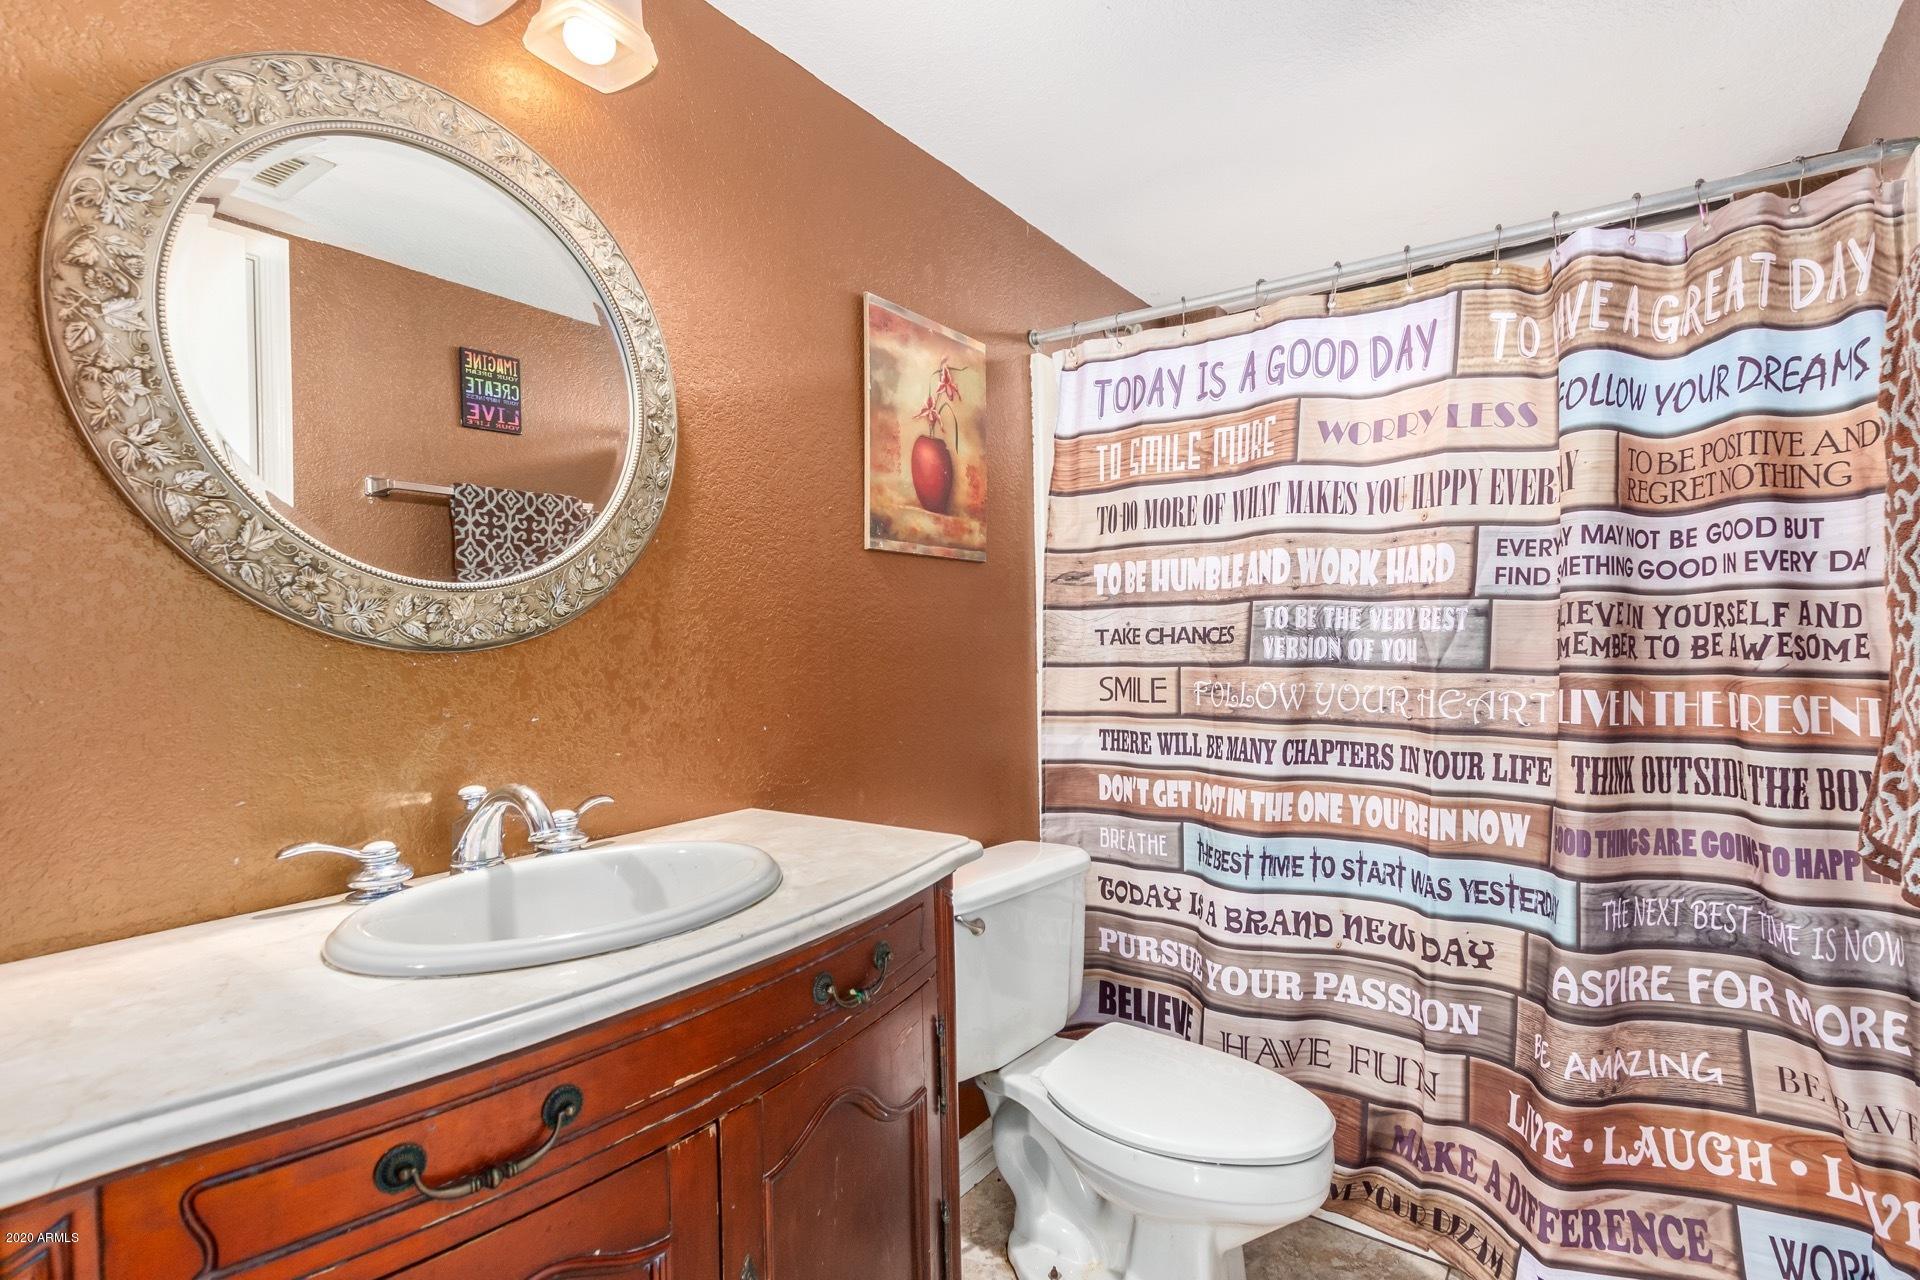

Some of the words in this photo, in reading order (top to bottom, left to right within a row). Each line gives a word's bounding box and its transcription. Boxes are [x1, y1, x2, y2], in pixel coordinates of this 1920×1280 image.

[1623, 284, 1639, 337] A
[1651, 252, 1776, 344] GREAT
[1790, 232, 1876, 313] DAY
[1489, 312, 1540, 361] TO
[1094, 365, 1185, 419] TODAY
[1197, 361, 1226, 401] IS
[1239, 350, 1256, 393] A
[1266, 338, 1359, 386] GOOD
[1370, 318, 1437, 381] DAY
[1655, 364, 1730, 416] YOUR
[1736, 336, 1871, 394] DREAMS
[1096, 442, 1121, 482] TO
[1130, 431, 1201, 476] SMILE
[1214, 415, 1276, 467] MORE
[1317, 405, 1438, 446] WORRY
[1446, 401, 1538, 429] LESS
[1628, 449, 1652, 474] TO
[1657, 448, 1696, 475] BE
[1701, 431, 1805, 468] POSITIVE
[1811, 419, 1881, 457] AND
[1097, 504, 1117, 536] TO
[1122, 500, 1138, 532] DO
[1144, 495, 1197, 530] MORE
[1202, 492, 1226, 526] OF
[1232, 481, 1281, 523] WHAT
[1286, 479, 1357, 515] MAKES
[1366, 476, 1406, 516] YOU
[1412, 468, 1483, 509] HAPPY
[1628, 473, 1716, 504] REGRET
[1719, 460, 1852, 497] NOTHING
[1581, 524, 1623, 545] MAY
[1626, 527, 1661, 549] NOT
[1669, 528, 1697, 549] BE
[1706, 516, 1777, 544] GOOD
[1784, 517, 1824, 540] BUT
[1094, 563, 1121, 595] TO
[1125, 560, 1147, 594] BE
[1151, 553, 1244, 592] HUMBLE
[1246, 549, 1291, 586] AND
[1297, 547, 1381, 587] WORK
[1386, 543, 1456, 586] HARD
[1494, 567, 1550, 586] FIND
[1638, 555, 1717, 580] GOOD
[1723, 553, 1736, 573] IN
[1744, 550, 1818, 572] EVERY
[1095, 627, 1140, 645] TAKE
[1145, 626, 1234, 645] CHANCES
[1264, 605, 1288, 629] TO
[1295, 605, 1317, 629] BE
[1323, 606, 1361, 630] THE
[1369, 606, 1415, 631] VERY
[1418, 607, 1468, 632] BEST
[1627, 603, 1644, 629] IN
[1654, 600, 1790, 631] YOURSELF
[1798, 600, 1862, 629] AND
[1263, 635, 1342, 661] VERSION
[1348, 637, 1375, 662] OF
[1380, 638, 1418, 663] YOU
[1644, 635, 1679, 660] TO
[1690, 633, 1723, 660] BE
[1729, 633, 1870, 662] AWESOME
[1099, 676, 1167, 704] SMILE
[1194, 680, 1305, 711] FOLLOW
[1315, 682, 1412, 719] YOUR
[1417, 687, 1555, 727] HEART
[1559, 689, 1620, 727] LIVE
[1623, 689, 1644, 726] IN
[1650, 690, 1725, 727] THE
[1729, 692, 1882, 738] PRESENT
[1099, 729, 1152, 755] THERE
[1157, 732, 1201, 757] WILL
[1206, 734, 1224, 760] BE
[1226, 735, 1278, 765] MANY
[1282, 738, 1394, 771] CHAPTERS
[1400, 744, 1421, 774] IN
[1423, 749, 1485, 780] YOUR
[1492, 752, 1552, 787] LIFE
[1571, 755, 1635, 795] THINK
[1642, 755, 1747, 801] OUTSIDE
[1747, 762, 1810, 809] THE
[1098, 774, 1149, 805] DON'T
[1153, 780, 1191, 808] GET
[1195, 782, 1226, 816] LOST
[1226, 788, 1247, 819] IN
[1250, 791, 1294, 822] THE
[1298, 791, 1343, 824] ONE
[1349, 794, 1429, 838] YOU'RE
[1429, 807, 1456, 841] IN
[1462, 809, 1531, 848] NOW
[1100, 827, 1167, 857] BREATHE
[1595, 828, 1650, 858] THINGS
[1653, 827, 1697, 857] ARE
[1701, 830, 1758, 872] GOING
[1759, 846, 1790, 877] TO
[1197, 833, 1213, 867] THE
[1213, 844, 1253, 881] BEST
[1259, 845, 1305, 881] TIME
[1309, 845, 1335, 883] TO
[1341, 850, 1406, 893] START
[1411, 868, 1453, 901] WAS
[1459, 873, 1559, 924] YESTERDAY
[1098, 876, 1181, 912] TODAY
[1188, 891, 1203, 920] IS
[1205, 900, 1217, 928] A
[1224, 905, 1333, 940] BRAND
[1342, 913, 1415, 953] NEW
[1420, 932, 1495, 971] DAY
[1601, 898, 1630, 932] THE
[1633, 898, 1685, 928] NEXT
[1691, 900, 1754, 935] BEST
[1757, 910, 1801, 956] TIME
[1811, 926, 1836, 962] IS
[1843, 930, 1905, 968] NOW
[1099, 927, 1202, 983] PURSUE
[1206, 961, 1303, 1001] YOUR
[1312, 971, 1482, 1036] PASSION
[1098, 980, 1194, 1041] BELIEVE
[1552, 965, 1673, 1007] ASPIRE
[1688, 967, 1780, 1018] FOR
[1785, 987, 1912, 1057] MORE
[1220, 1030, 1332, 1069] HAVE
[1347, 1043, 1440, 1101] FUN
[1534, 1033, 1551, 1069] BE
[1563, 1048, 1724, 1085] AMAZING
[1778, 1065, 1826, 1102] BE
[1507, 1090, 1574, 1168] LIVE
[1602, 1125, 1777, 1186] LAUGH
[1391, 1125, 1478, 1185] MAKE
[1483, 1160, 1501, 1202] A
[1506, 1172, 1713, 1263] DIFFERENCE
[1362, 1180, 1427, 1227] YOUR
[1433, 1208, 1504, 1279] DREAM
